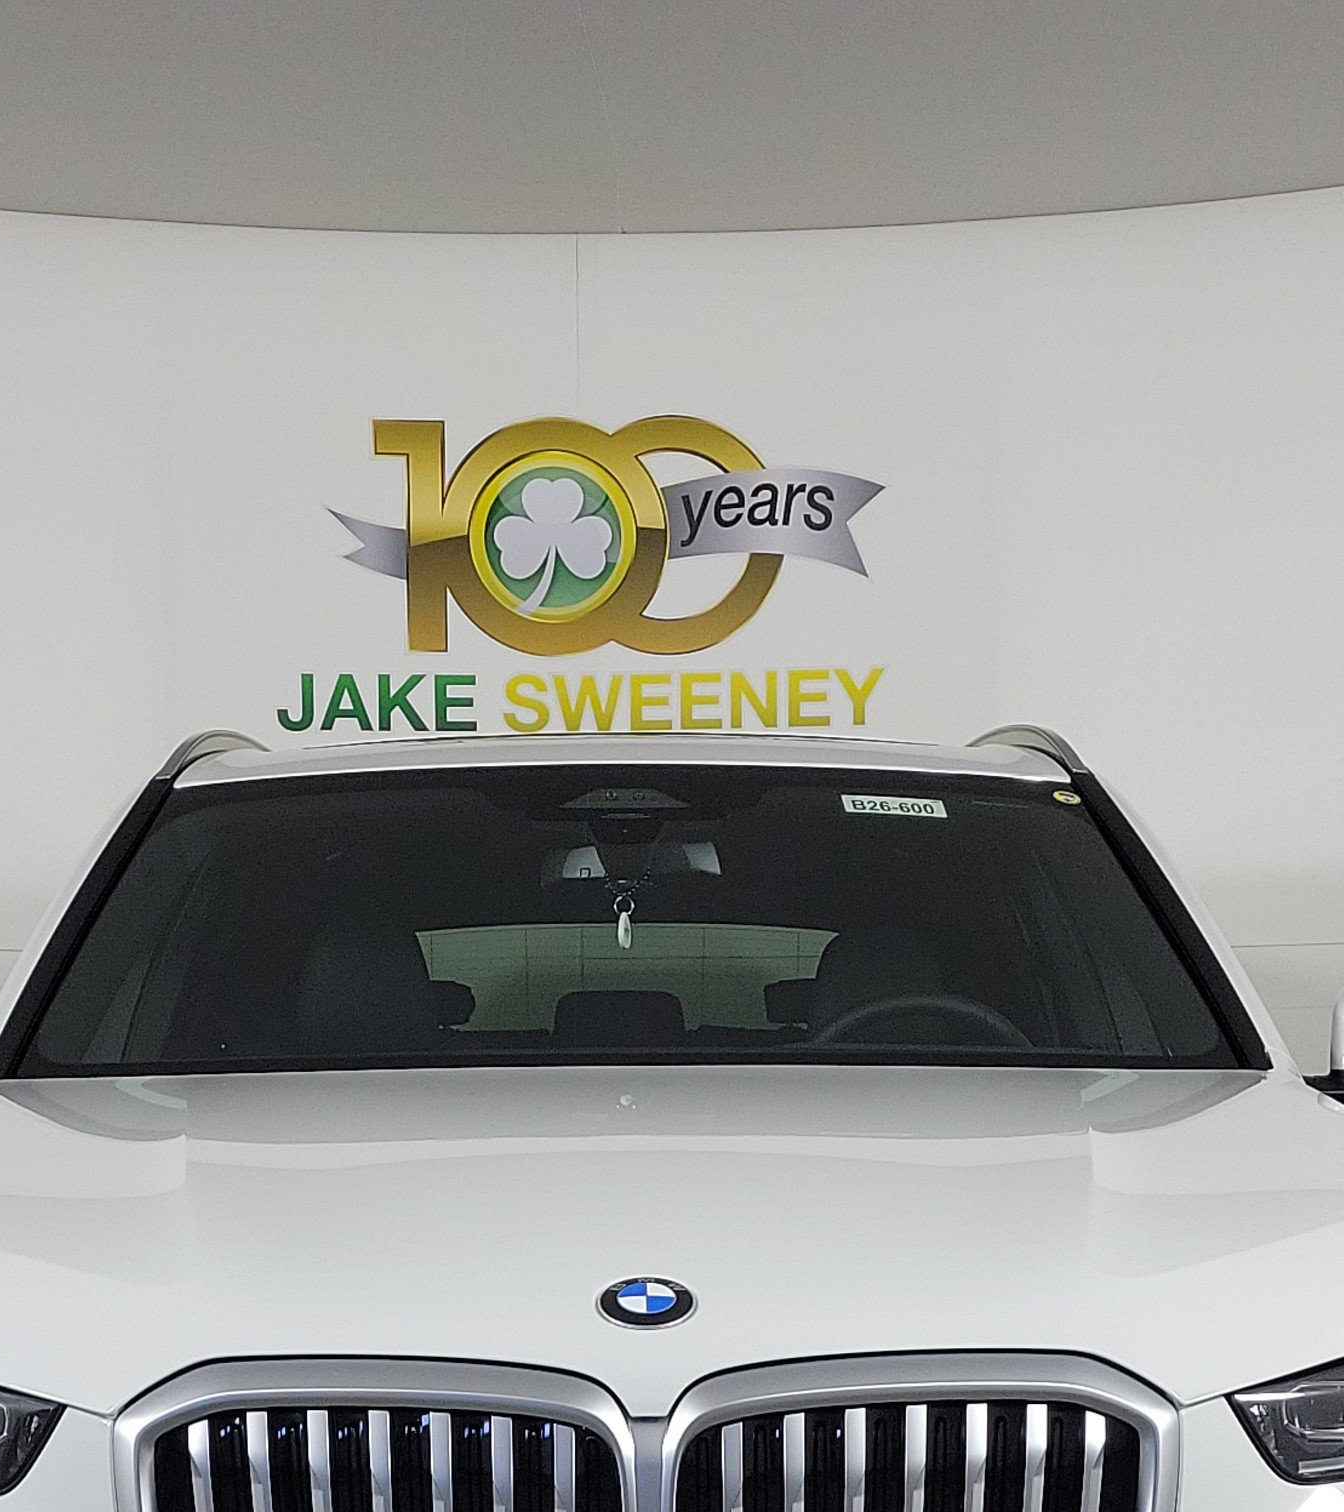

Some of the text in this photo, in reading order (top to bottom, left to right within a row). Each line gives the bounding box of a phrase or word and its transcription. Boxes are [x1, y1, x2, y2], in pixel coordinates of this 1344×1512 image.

[372, 415, 783, 655] 100
[679, 480, 834, 547] years
[277, 667, 885, 733] JAKE SWEENEY
[851, 800, 935, 814] B26-600
